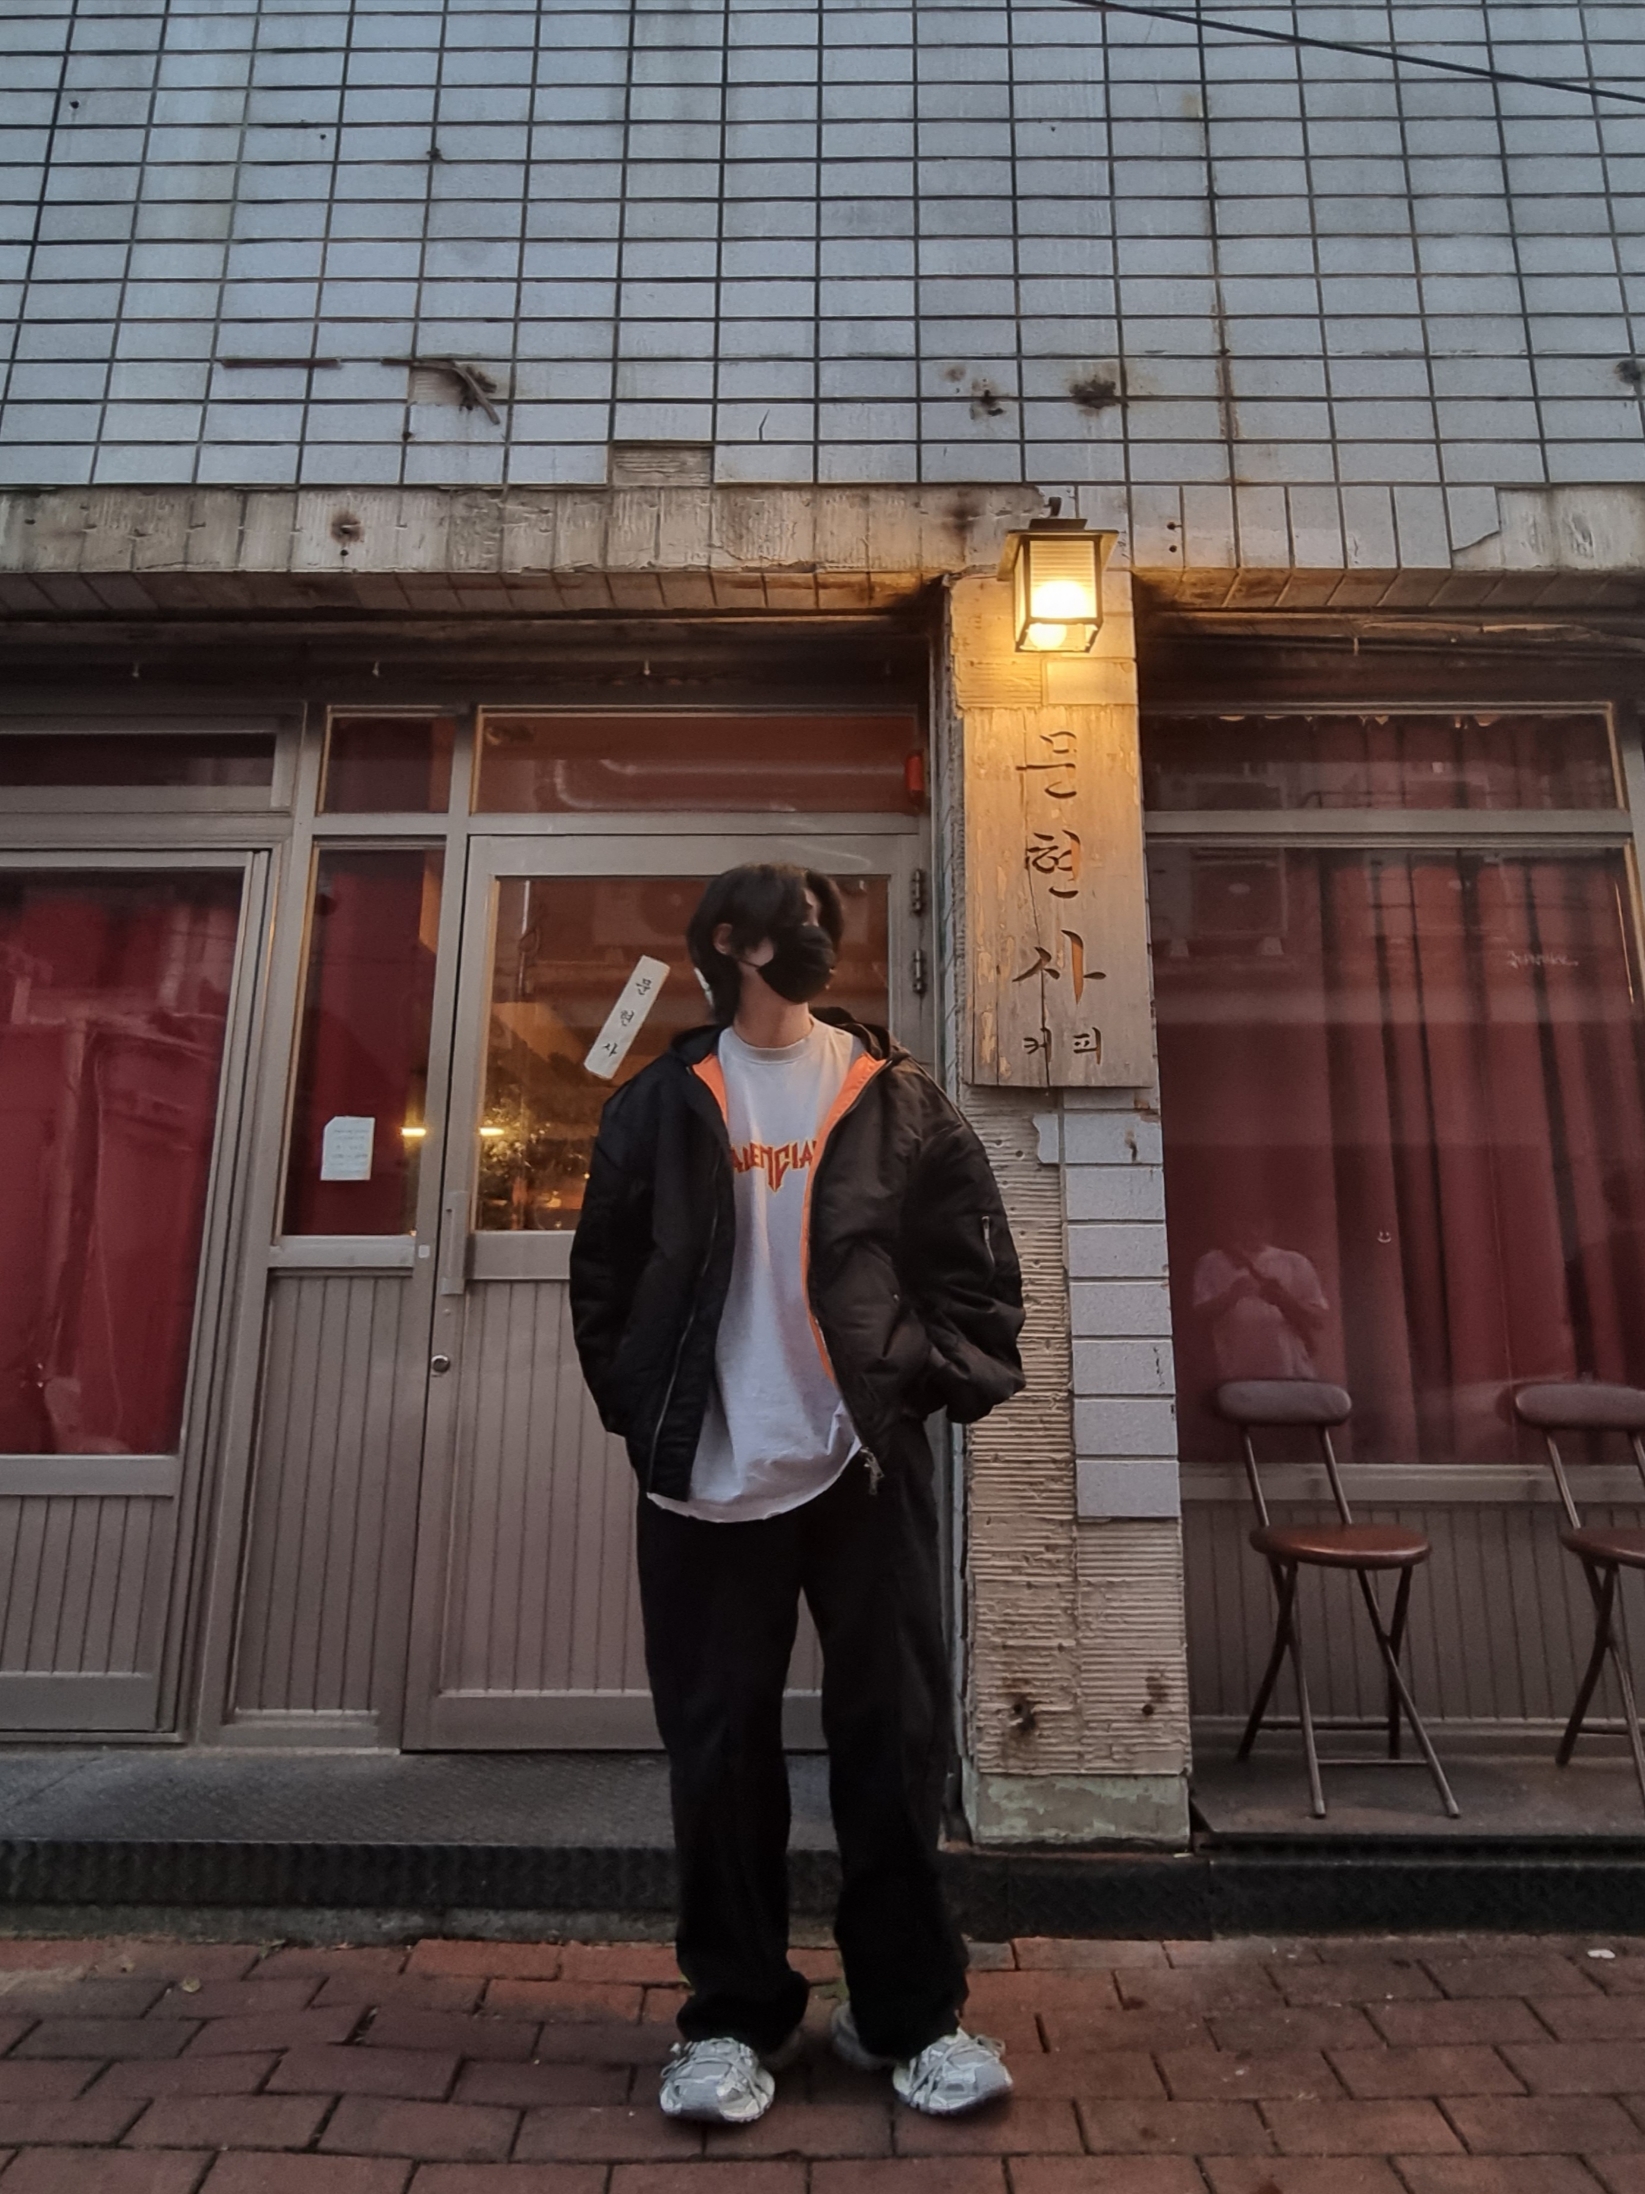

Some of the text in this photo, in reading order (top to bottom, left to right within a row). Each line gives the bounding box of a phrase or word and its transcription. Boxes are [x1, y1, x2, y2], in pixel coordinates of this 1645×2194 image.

[1012, 730, 1107, 1005] 문현사
[602, 978, 652, 1058] 문현사
[1023, 1026, 1102, 1065] 커피
